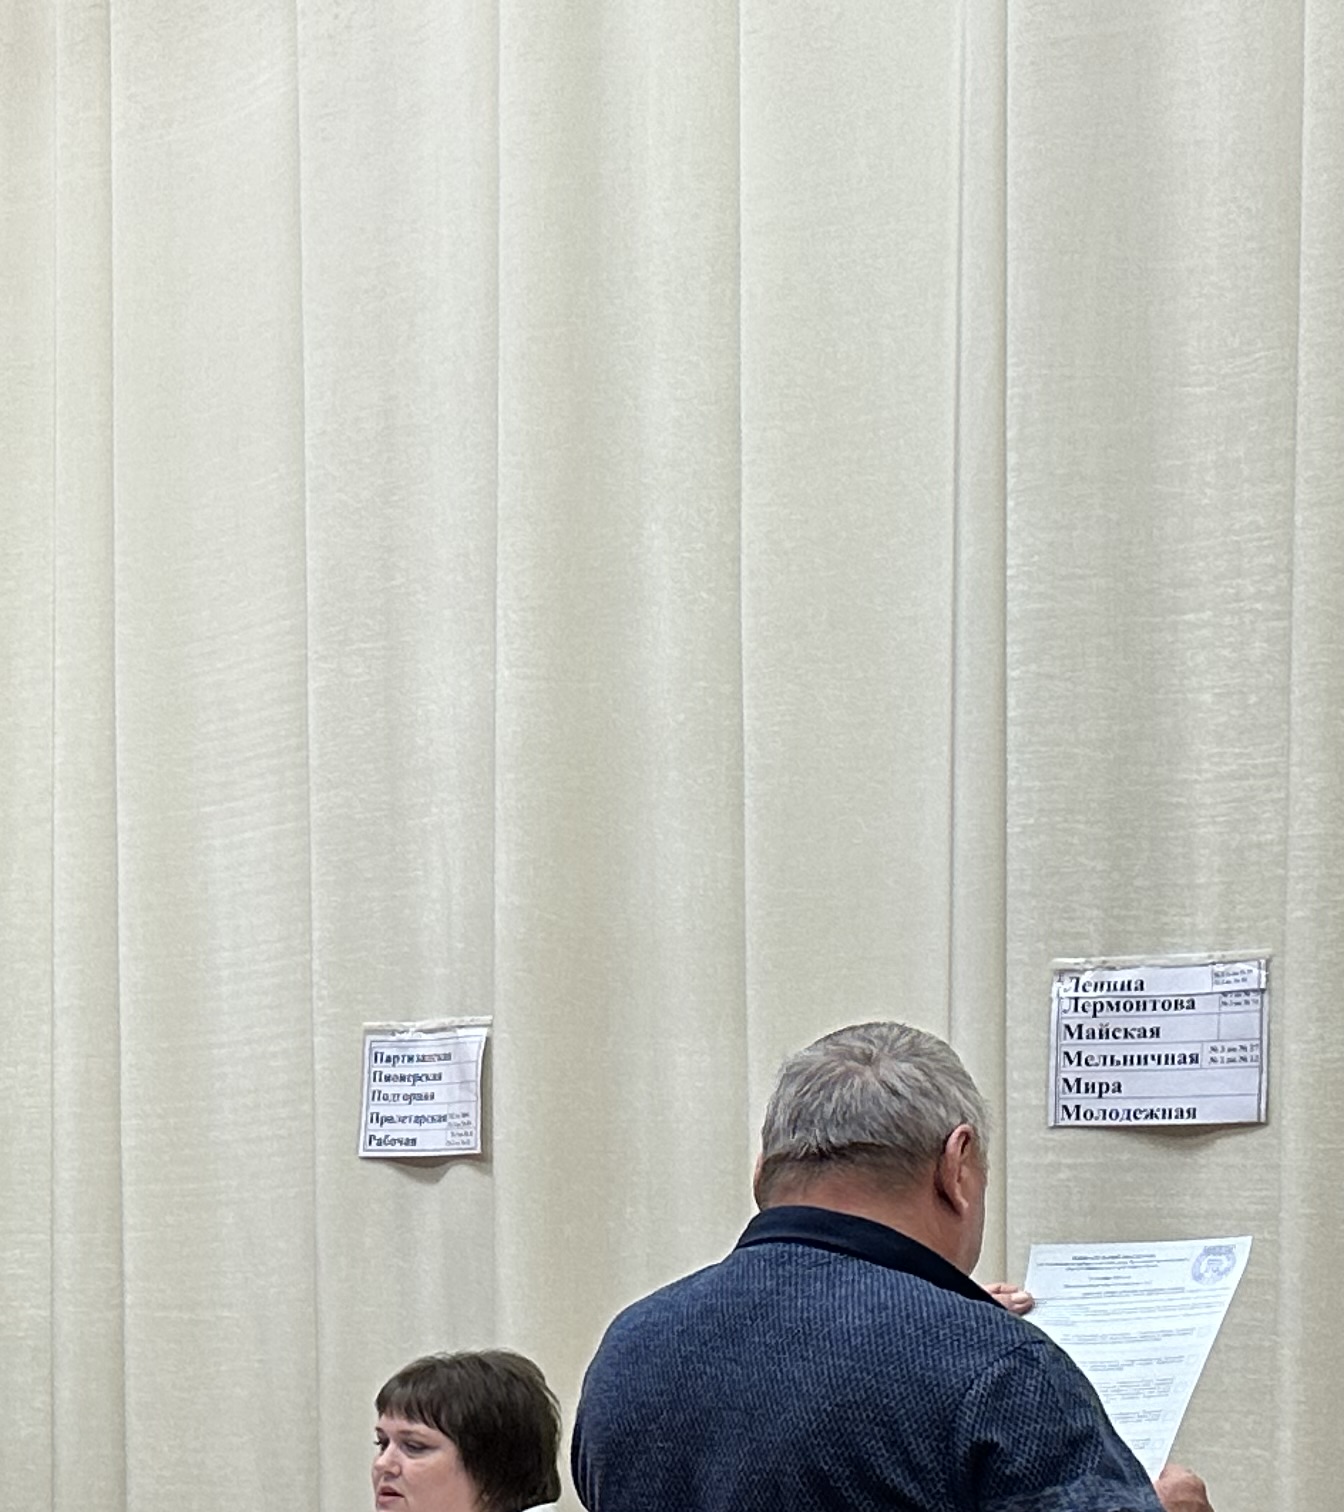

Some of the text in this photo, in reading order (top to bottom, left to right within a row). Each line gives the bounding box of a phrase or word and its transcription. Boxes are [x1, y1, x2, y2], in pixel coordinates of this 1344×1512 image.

[1062, 976, 1145, 993] Ленина
[1062, 996, 1197, 1018] Лермонтова
[1062, 1022, 1161, 1041] Майская
[1062, 1050, 1200, 1067] Мельничная
[1061, 1077, 1123, 1098] Мира
[1060, 1104, 1197, 1122] Молодежная
[368, 1134, 417, 1147] Рабочая
